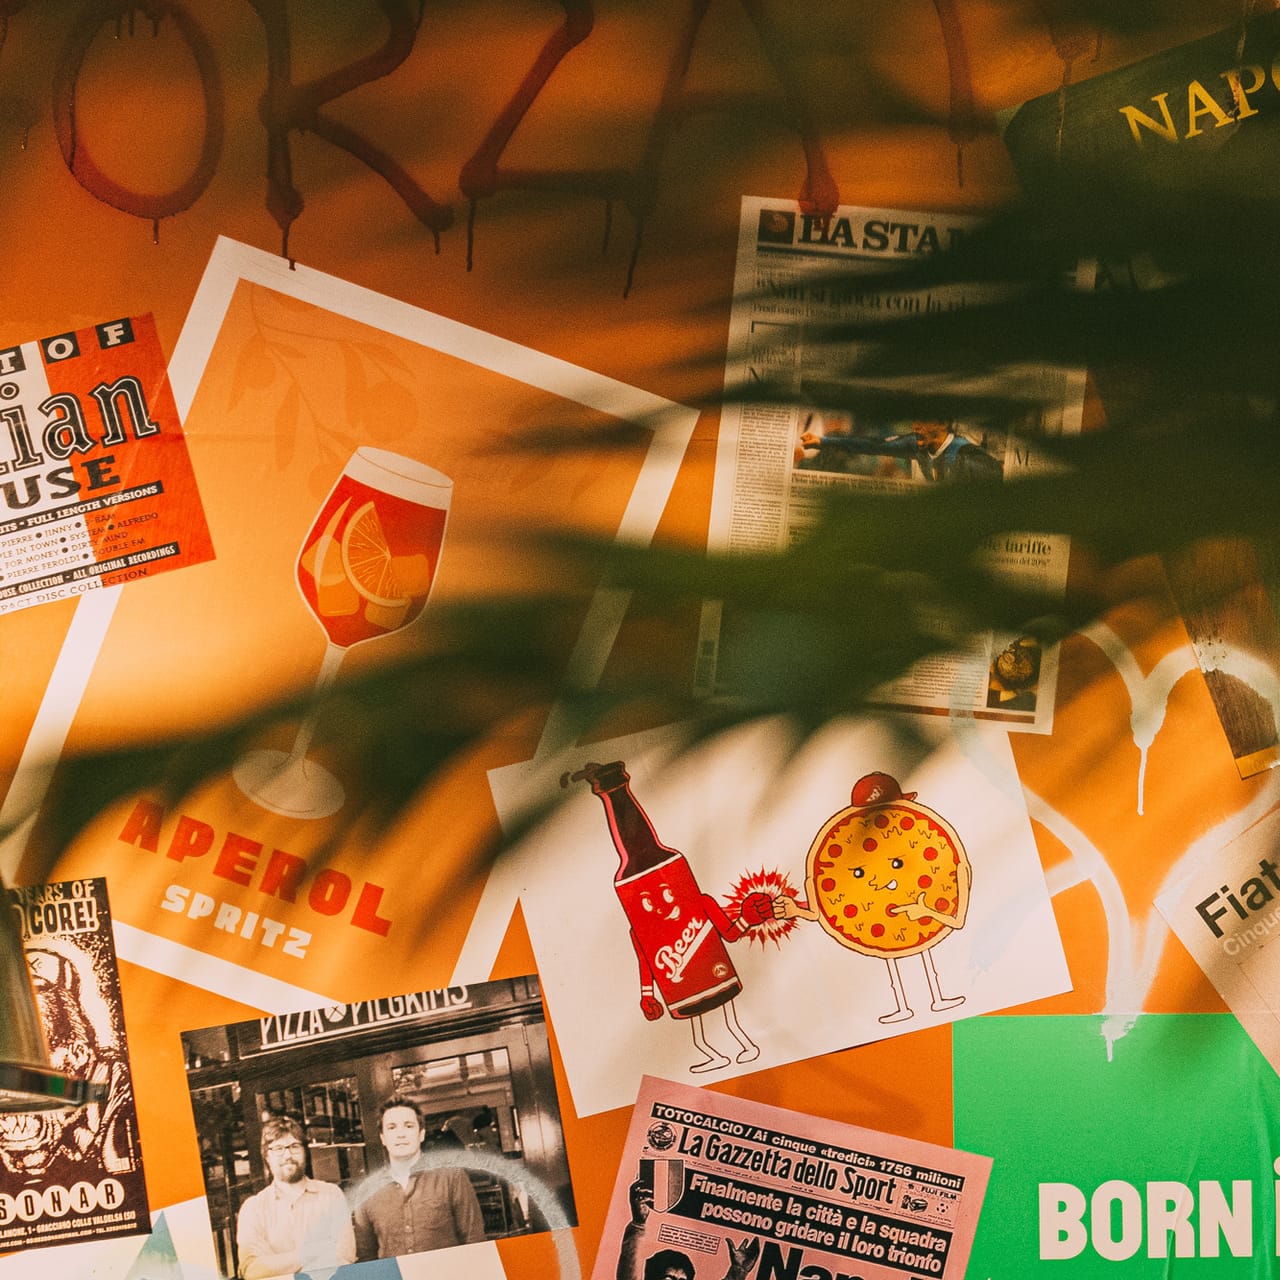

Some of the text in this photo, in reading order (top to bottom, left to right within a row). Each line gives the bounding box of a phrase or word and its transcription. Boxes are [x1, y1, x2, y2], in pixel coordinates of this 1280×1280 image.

[47, 323, 125, 360] OF
[27, 512, 54, 527] FULL
[57, 502, 100, 519] LENGTH
[102, 486, 158, 504] VERSIONS
[30, 538, 58, 553] TOWN
[117, 512, 159, 529] ALFREDO
[7, 565, 39, 579] PIERRE
[42, 554, 81, 571] FEROLDI
[18, 574, 64, 594] COLLECTION
[73, 569, 86, 581] ALL
[89, 559, 127, 576] ORIGINAL
[128, 545, 176, 565] RECORDINGS
[26, 549, 60, 564] MONEY
[36, 589, 65, 603] DISC
[70, 567, 148, 595] COLLECTION
[71, 880, 95, 898] OF
[118, 799, 392, 937] APEROL
[161, 884, 313, 959] SPRITZ
[654, 917, 703, 979] Beer
[655, 1105, 962, 1189] TOTOCALCIO Ai cinque «tredici» 1756 milioni
[677, 1127, 704, 1158] La
[705, 1133, 793, 1180] Gazzetta
[793, 1157, 838, 1191] dello
[839, 1166, 897, 1204] Sport
[689, 1175, 947, 1253] Finalmente la città e la squadra
[700, 1200, 942, 1273] possono gridare il loro trionfo
[1038, 1180, 1253, 1261] BORN
